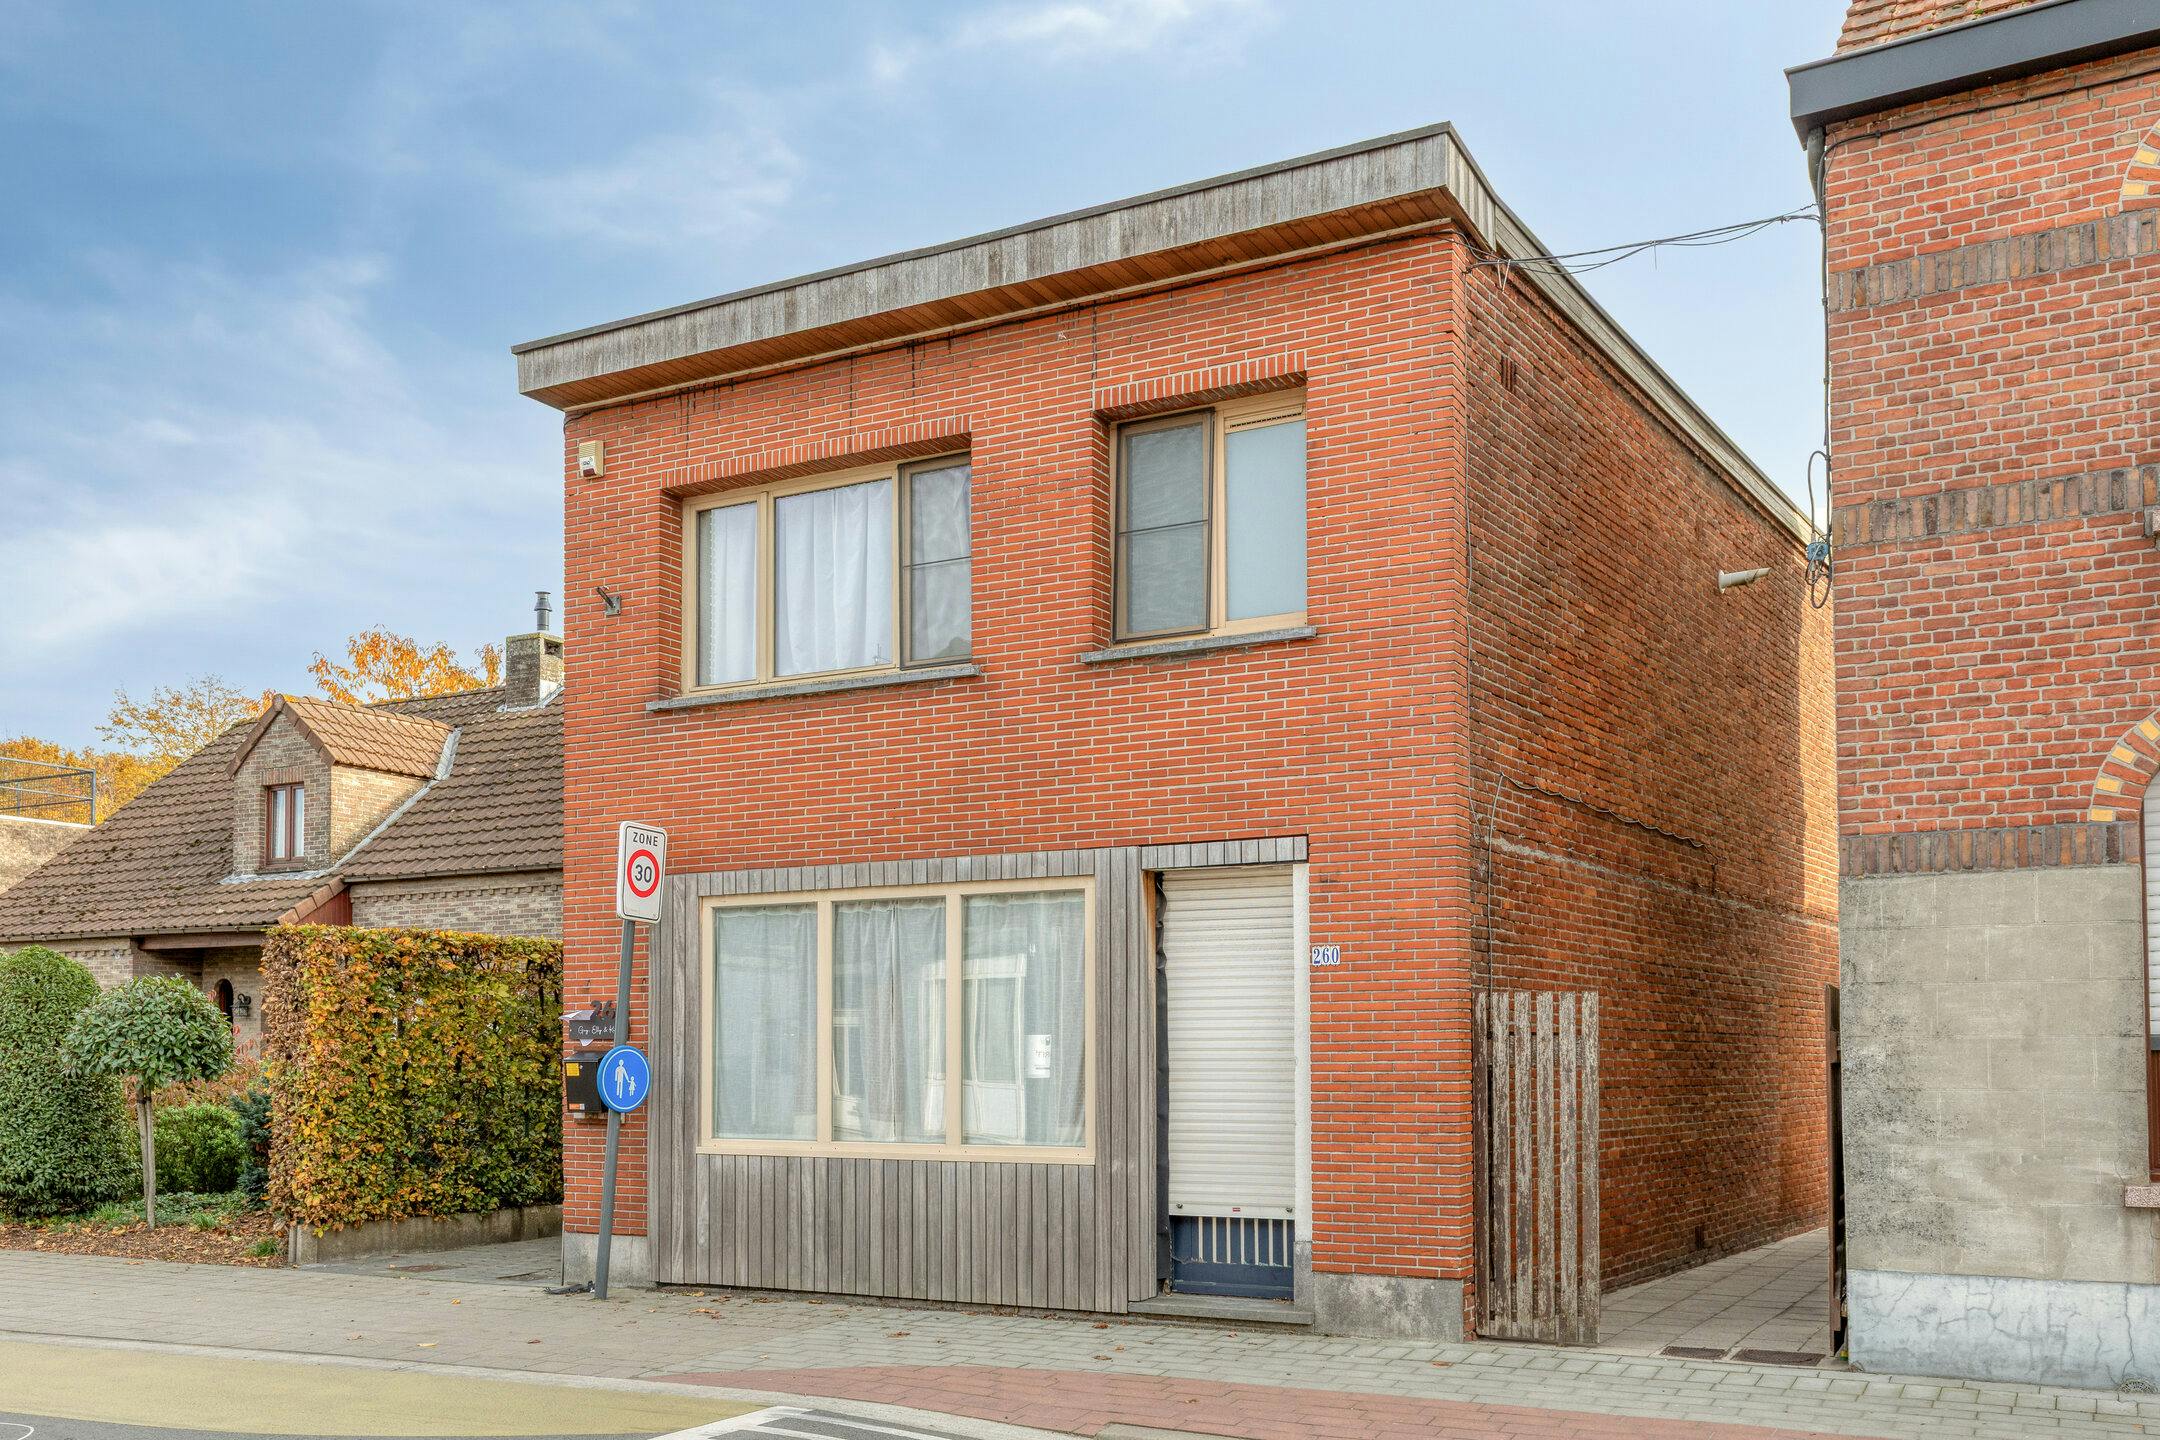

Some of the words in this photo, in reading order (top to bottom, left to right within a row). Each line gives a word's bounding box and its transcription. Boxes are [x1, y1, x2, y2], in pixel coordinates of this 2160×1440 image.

[633, 832, 659, 847] ZONE
[634, 864, 653, 883] 30
[1313, 947, 1339, 965] 260
